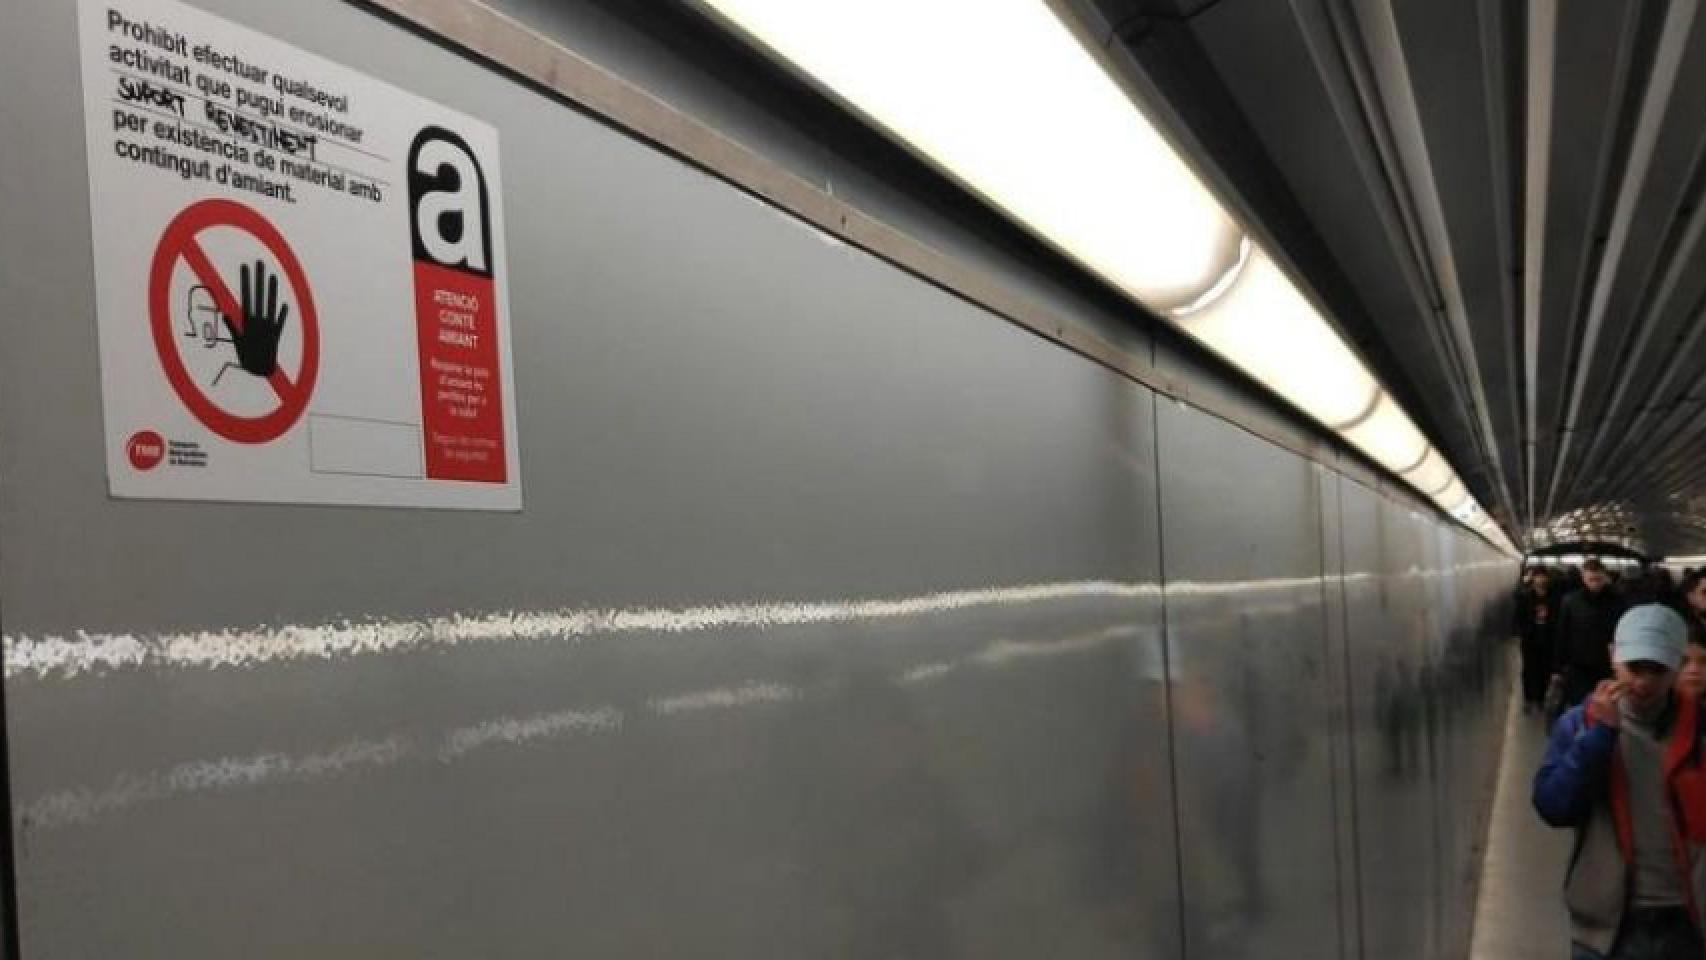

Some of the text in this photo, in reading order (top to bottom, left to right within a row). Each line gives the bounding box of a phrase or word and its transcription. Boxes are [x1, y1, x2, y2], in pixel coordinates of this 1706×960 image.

[107, 9, 348, 113] Prohibit efectuar qualsevol
[109, 45, 363, 143] activitat que pugui erosionar
[113, 109, 382, 203] per existència de material amb
[115, 139, 297, 203] contingut d'amiant.
[417, 138, 487, 271] a
